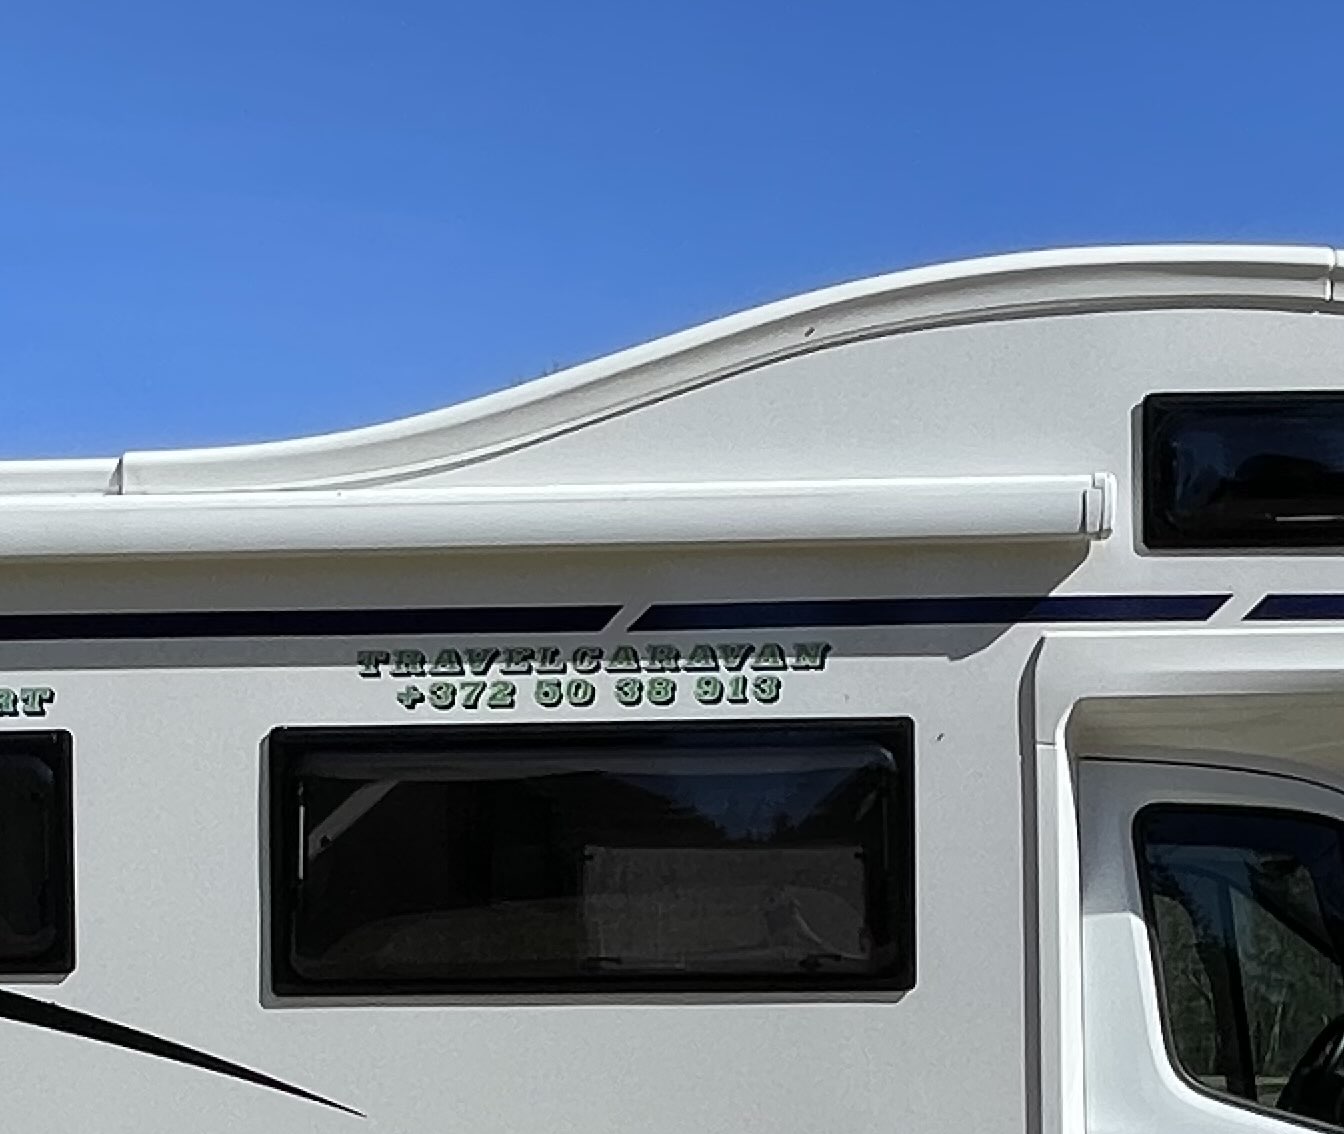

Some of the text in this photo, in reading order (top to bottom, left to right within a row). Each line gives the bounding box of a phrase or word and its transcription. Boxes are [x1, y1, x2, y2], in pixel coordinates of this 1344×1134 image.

[357, 642, 833, 677] TRAVELCARAVAN
[396, 675, 782, 709] +372 50 38 913
